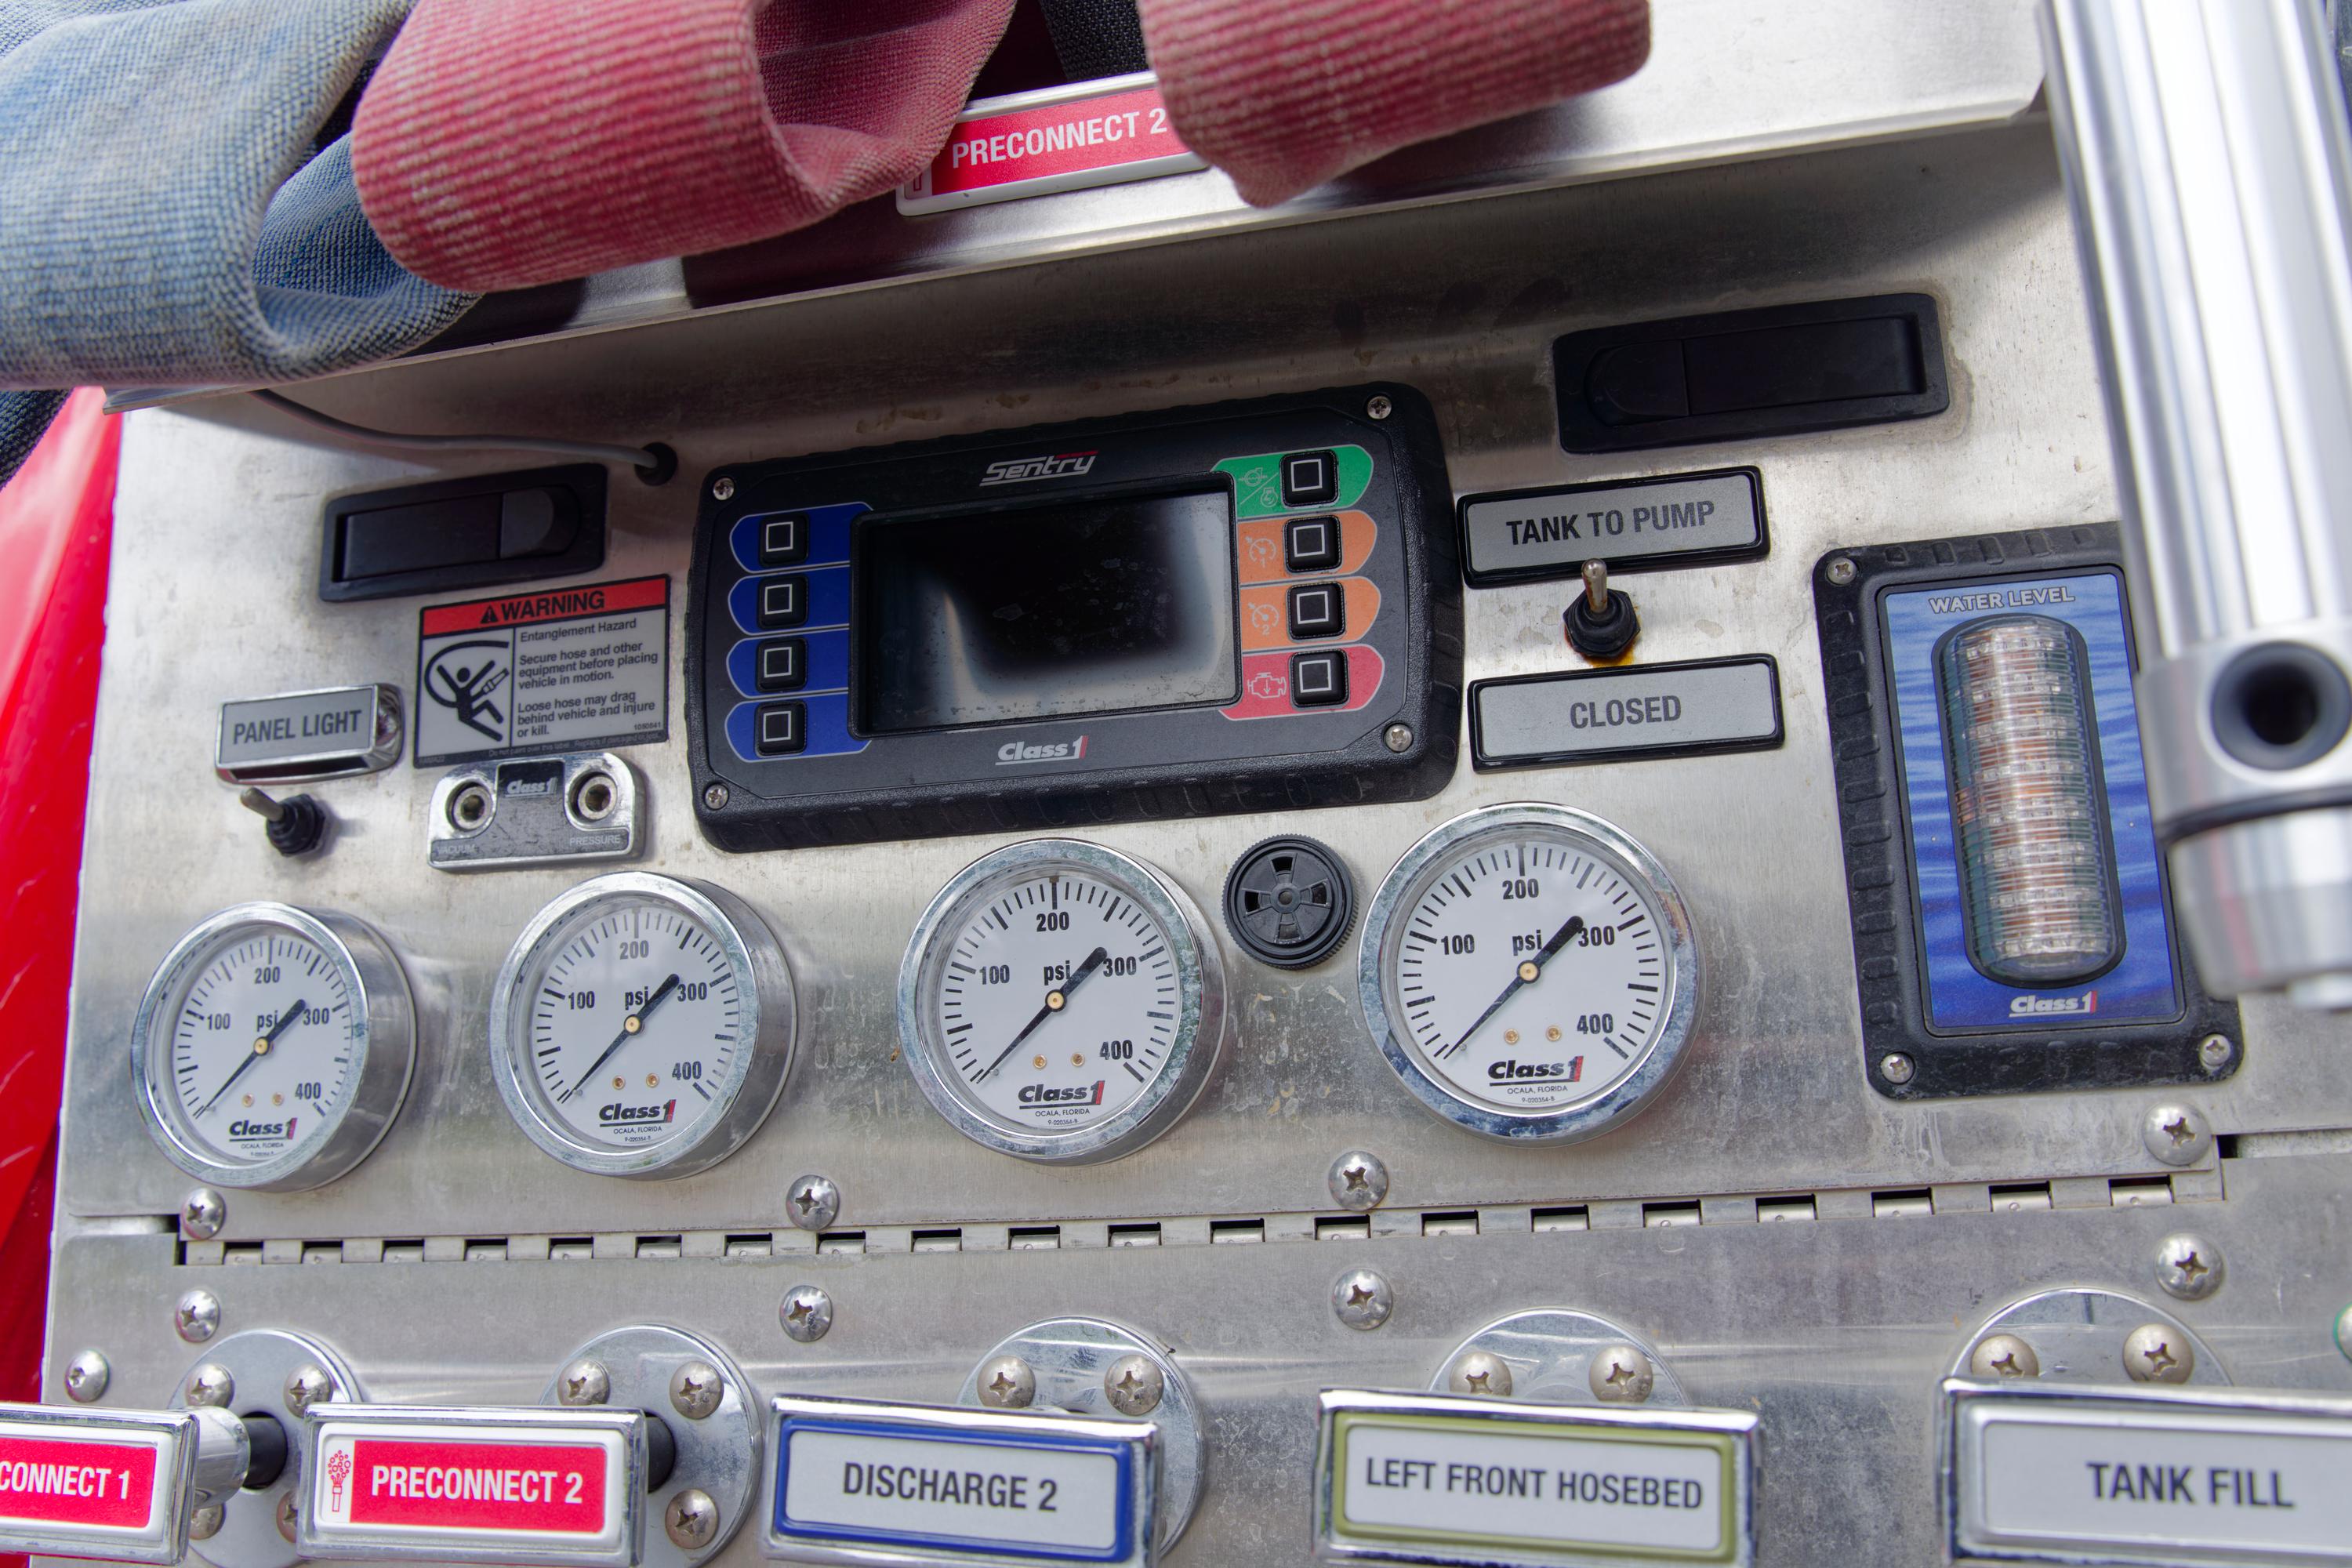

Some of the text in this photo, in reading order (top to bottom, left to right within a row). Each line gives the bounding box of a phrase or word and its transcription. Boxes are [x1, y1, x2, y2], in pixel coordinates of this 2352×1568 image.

[953, 107, 1167, 169] PRECONNECT 2
[981, 455, 1097, 483] Sentry
[1506, 500, 1715, 546] TANK TO PUMP
[500, 590, 605, 622] WARNING
[1929, 586, 2076, 614] WATER LEVEL
[520, 618, 637, 643] Entanglement Hazard
[519, 641, 643, 666] Secure hose and other
[518, 652, 659, 679] equipment before placing
[518, 670, 615, 690] vehicle in motion.
[517, 691, 637, 713] Loose hose may drag
[1570, 695, 1682, 730] CLOSED
[517, 701, 655, 726] behind vehicle and injure
[233, 709, 362, 745] PANEL LIGHT
[517, 724, 550, 738] or kill.
[436, 843, 477, 855] VACUUM
[568, 833, 622, 848] PRESSURE
[1501, 877, 1540, 900] 200
[1036, 911, 1070, 932] 200
[1440, 933, 1475, 956] 100
[1512, 929, 1543, 956] psi
[1577, 925, 1615, 948] 300
[619, 940, 650, 960] 200
[254, 966, 281, 985] 200
[978, 964, 1011, 985] 100
[1043, 960, 1073, 985] psi
[1102, 956, 1138, 978] 300
[568, 990, 596, 1011] 100
[624, 985, 650, 1011] psi
[676, 982, 708, 1003] 300
[206, 1013, 232, 1031] 100
[256, 1010, 279, 1032] psi
[302, 1007, 331, 1026] 300
[1577, 1013, 1614, 1035] 400
[1098, 1039, 1134, 1061] 400
[671, 1061, 702, 1081] 400
[294, 1081, 322, 1100] 400
[1506, 1084, 1569, 1095] OCALA, FLORIDA
[1034, 1108, 1091, 1118] OCALA, FLORIDA
[612, 1125, 663, 1135] OCALA, FLORIDA
[0, 1460, 131, 1501] CONNECT 1
[371, 1464, 584, 1504] PRECONNECT 2
[843, 1461, 1059, 1513] DISCHARGE 2
[1366, 1456, 1704, 1510] LEFT FRONT HOSEBED
[2085, 1461, 2296, 1508] TANK FILL
